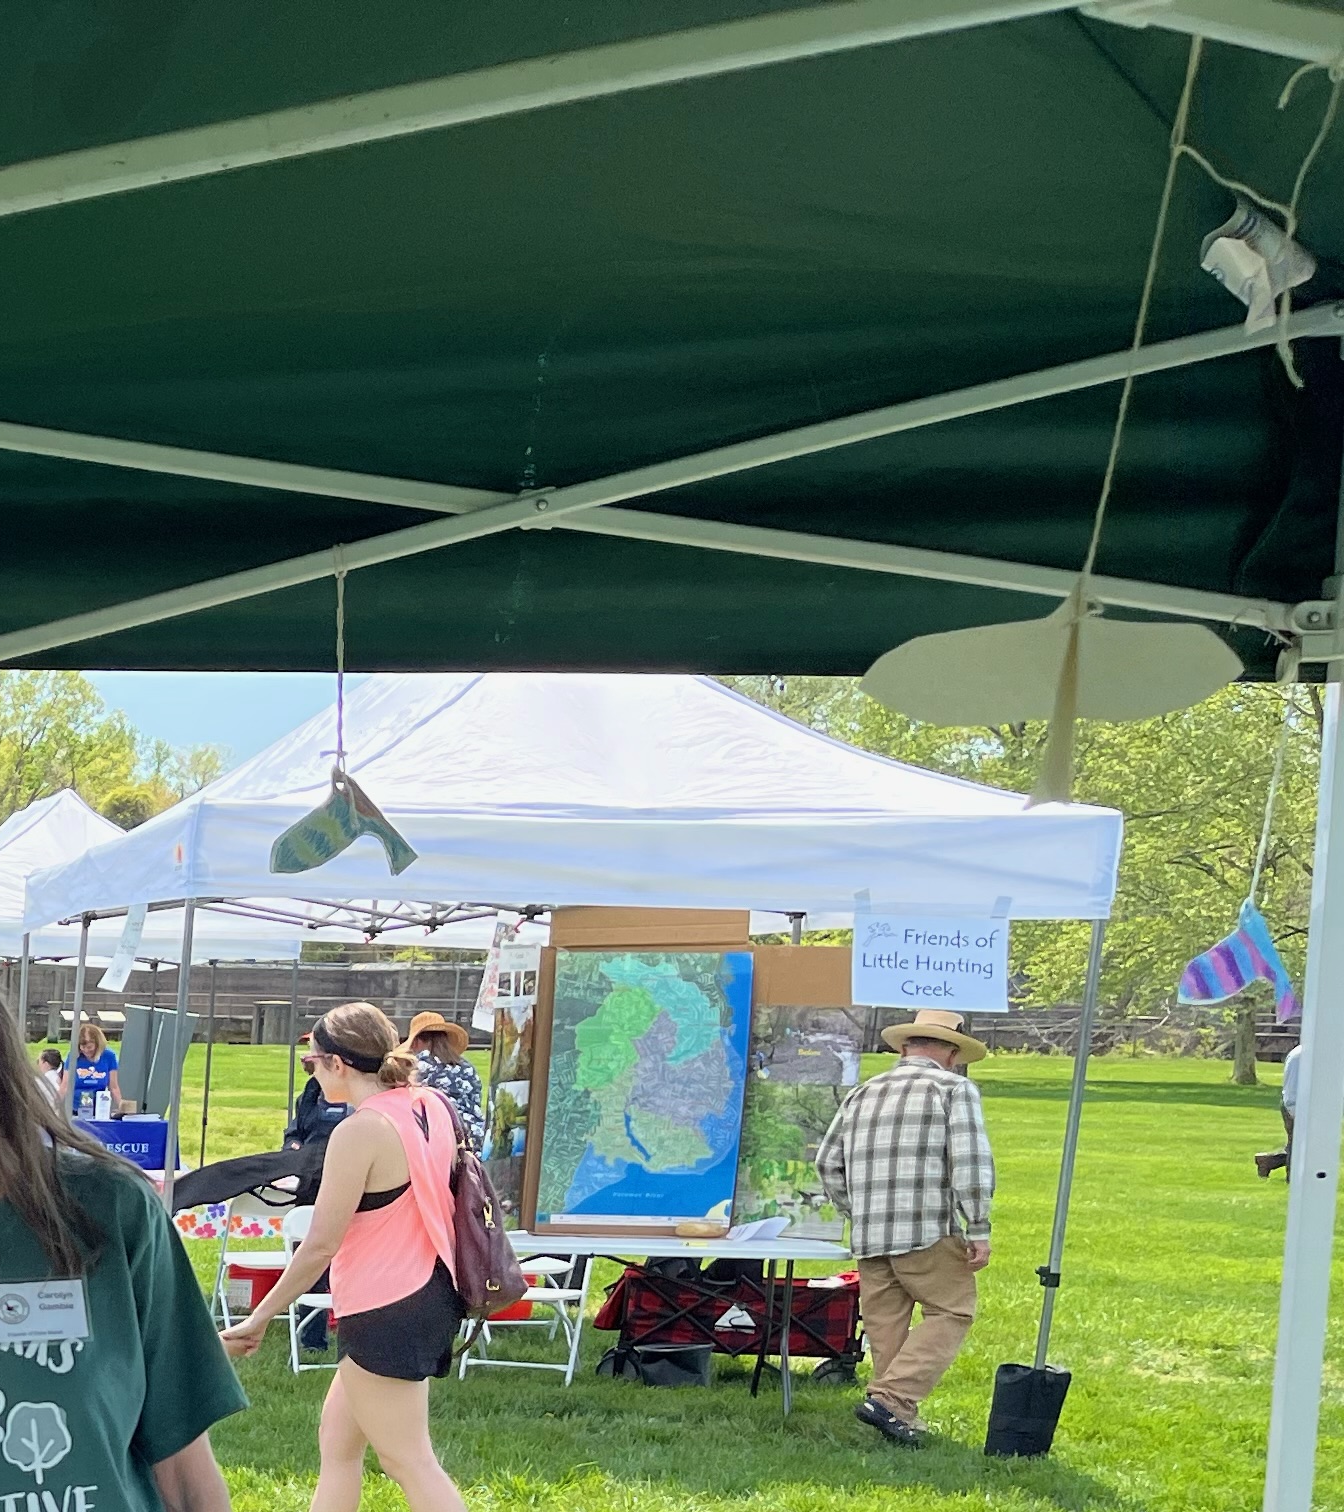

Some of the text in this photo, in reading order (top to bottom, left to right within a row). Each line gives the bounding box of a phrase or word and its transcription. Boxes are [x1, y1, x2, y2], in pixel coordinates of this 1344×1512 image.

[904, 929, 1000, 948] Friends of
[862, 951, 993, 980] Little Hunting
[901, 980, 955, 997] Creek
[106, 1143, 149, 1153] ESCUE
